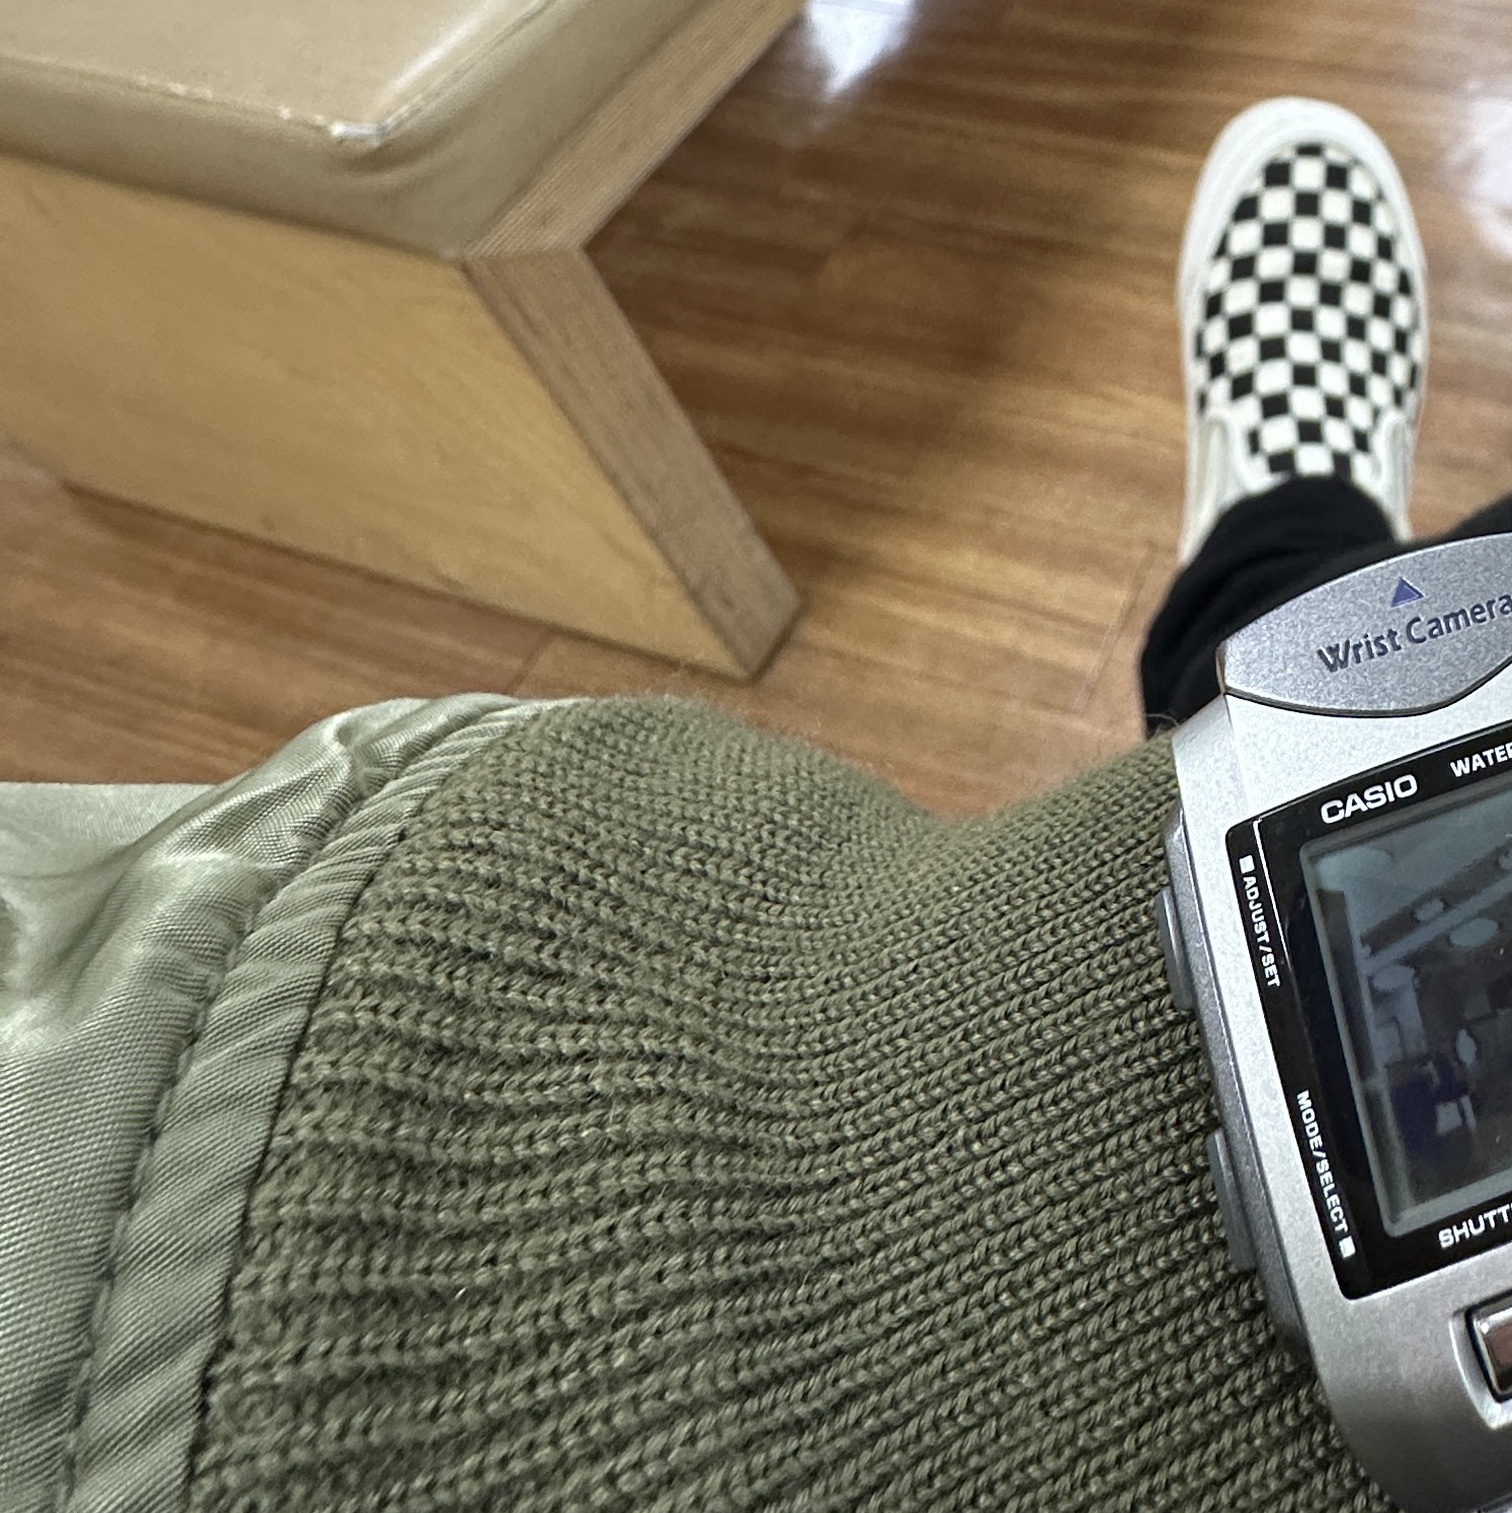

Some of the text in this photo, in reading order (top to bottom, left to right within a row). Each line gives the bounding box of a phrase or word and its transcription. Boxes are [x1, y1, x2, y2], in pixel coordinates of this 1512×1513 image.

[1316, 627, 1402, 674] Wrist
[1320, 773, 1419, 825] CASIO
[1242, 875, 1281, 987] ADJUST/SET
[1296, 1089, 1349, 1234] MODE/SELECT
